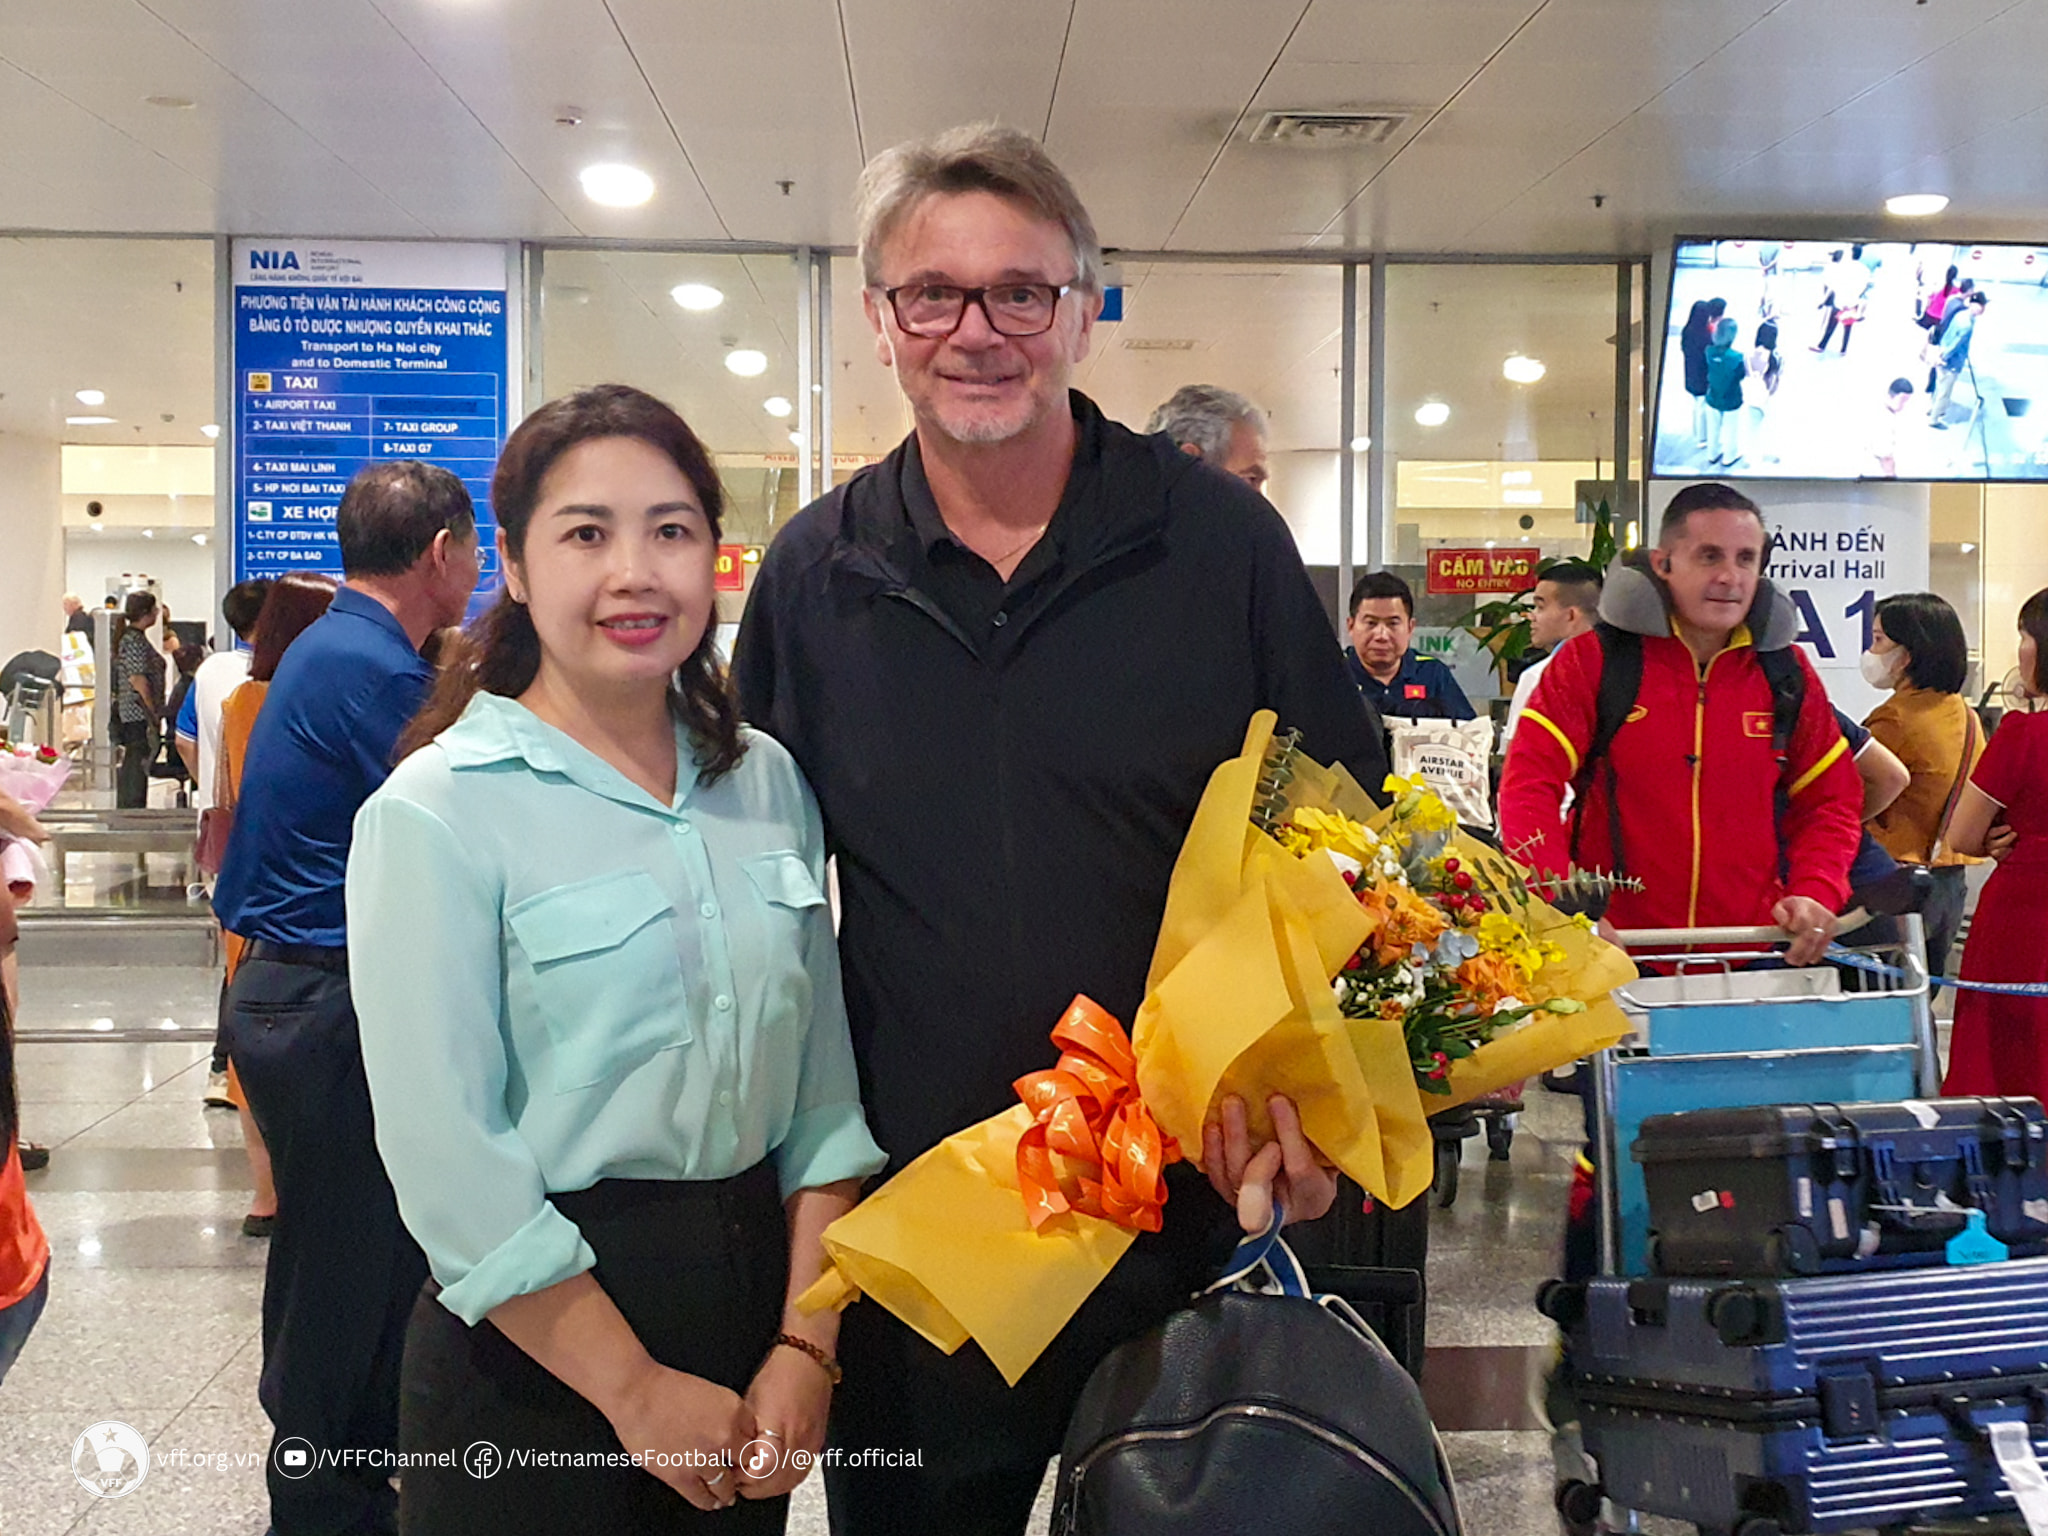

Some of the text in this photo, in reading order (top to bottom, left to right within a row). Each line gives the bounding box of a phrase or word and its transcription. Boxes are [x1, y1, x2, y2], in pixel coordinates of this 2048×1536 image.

[250, 250, 300, 270] NIA
[241, 292, 501, 317] PHƯƠNG TIỆN VẬN TẢI HÀNH KHÁCH CÔNG CỘNG
[283, 315, 292, 333] Ô
[294, 315, 310, 333] TÔ
[311, 319, 343, 337] ĐƯỢC
[345, 319, 392, 337] NHƯỢNG
[434, 320, 461, 336] KHAI
[462, 319, 493, 336] THÁC
[301, 340, 442, 356] Transport to Ha Noi city
[291, 357, 448, 370] and to Domestic Terminal
[282, 376, 318, 389] TAXI
[264, 399, 310, 410] AIRPORT
[313, 400, 336, 410] TAXI
[264, 420, 288, 431] TAXI
[290, 419, 314, 433] VIỆT
[316, 421, 352, 432] THANH
[395, 422, 419, 433] TAXI
[421, 422, 458, 433] GROUP
[418, 443, 432, 454] G7
[264, 462, 288, 473] TAXI
[290, 462, 310, 473] MAI
[311, 463, 337, 474] LINH
[264, 483, 279, 493] HP
[321, 484, 346, 494] TAXI
[282, 506, 304, 519] XE
[1772, 524, 1884, 552] ẢNH ĐẾN
[1440, 553, 1529, 576] CẤM VÀO
[1765, 560, 1884, 579] rrival Hall
[1456, 579, 1511, 588] NO ENTRY
[1420, 755, 1464, 768] AIRSTAR
[1420, 766, 1464, 779] AVENUE
